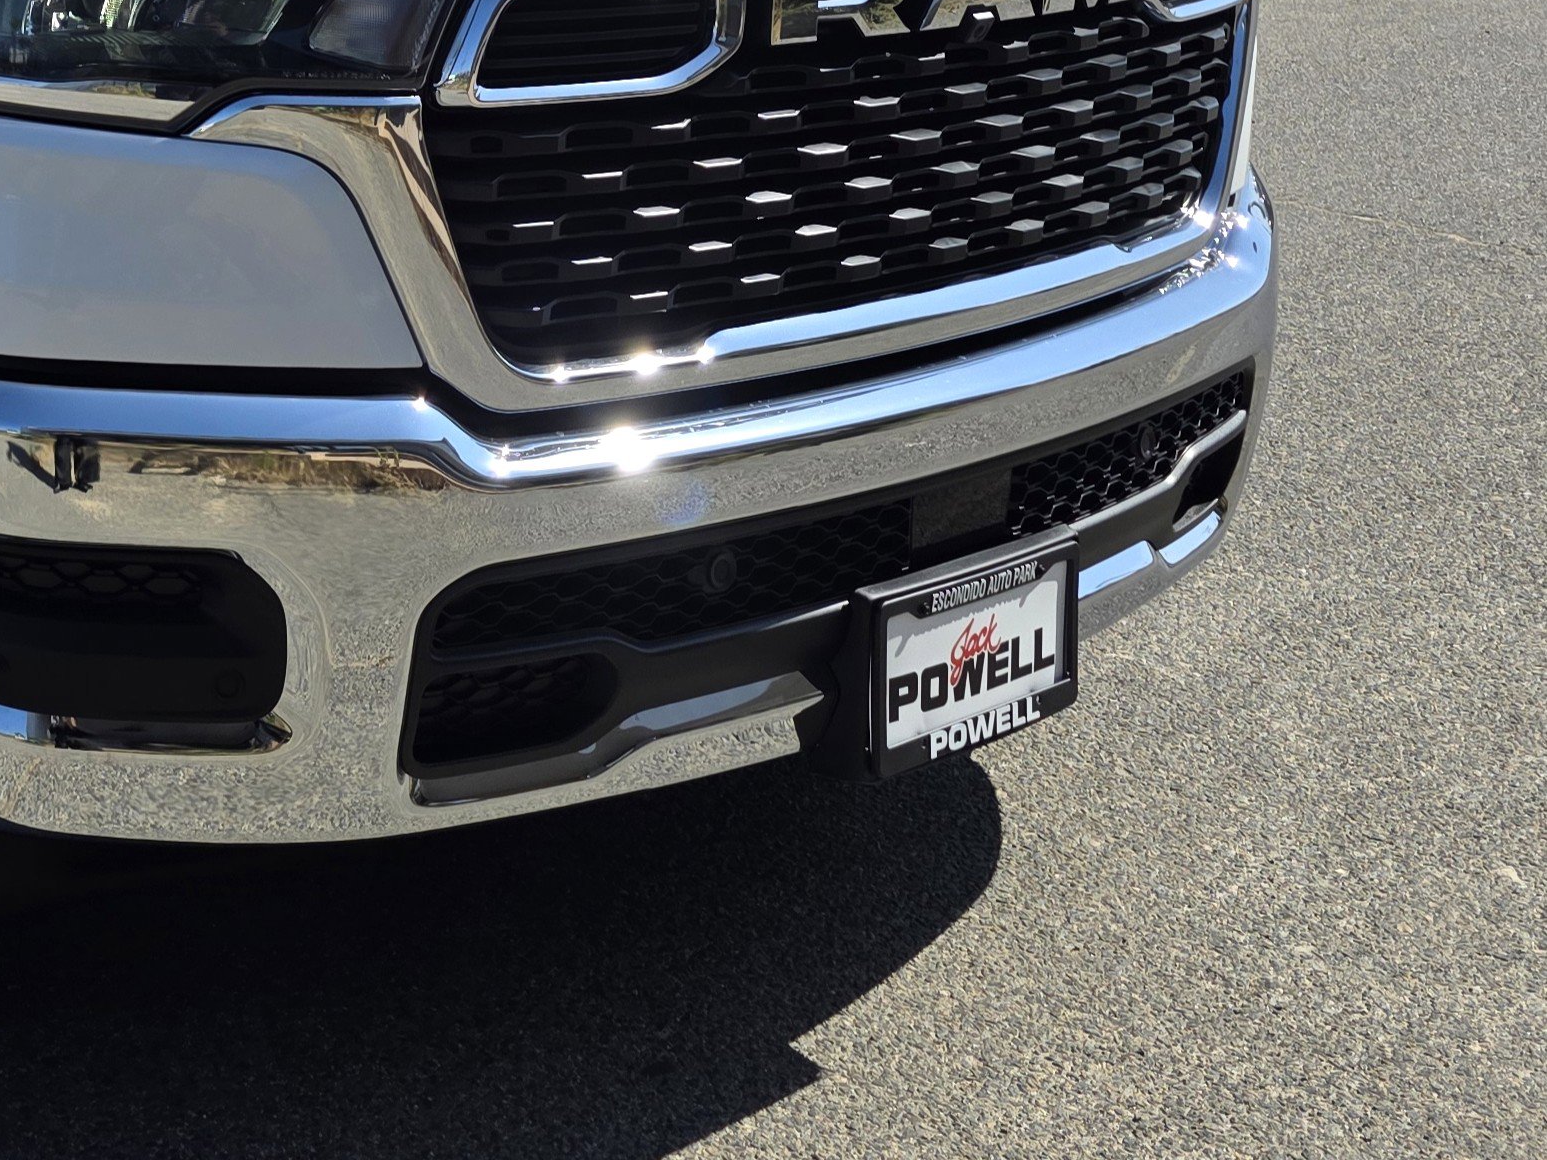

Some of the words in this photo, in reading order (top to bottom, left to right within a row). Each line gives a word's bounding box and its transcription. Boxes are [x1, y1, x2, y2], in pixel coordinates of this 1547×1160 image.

[931, 578, 987, 613] ESCONDIDO
[987, 569, 1013, 596] AUTO
[1012, 560, 1038, 587] PARK
[888, 627, 1056, 724] POWELL
[950, 613, 1002, 687] Jack
[930, 695, 1041, 760] POWELL
